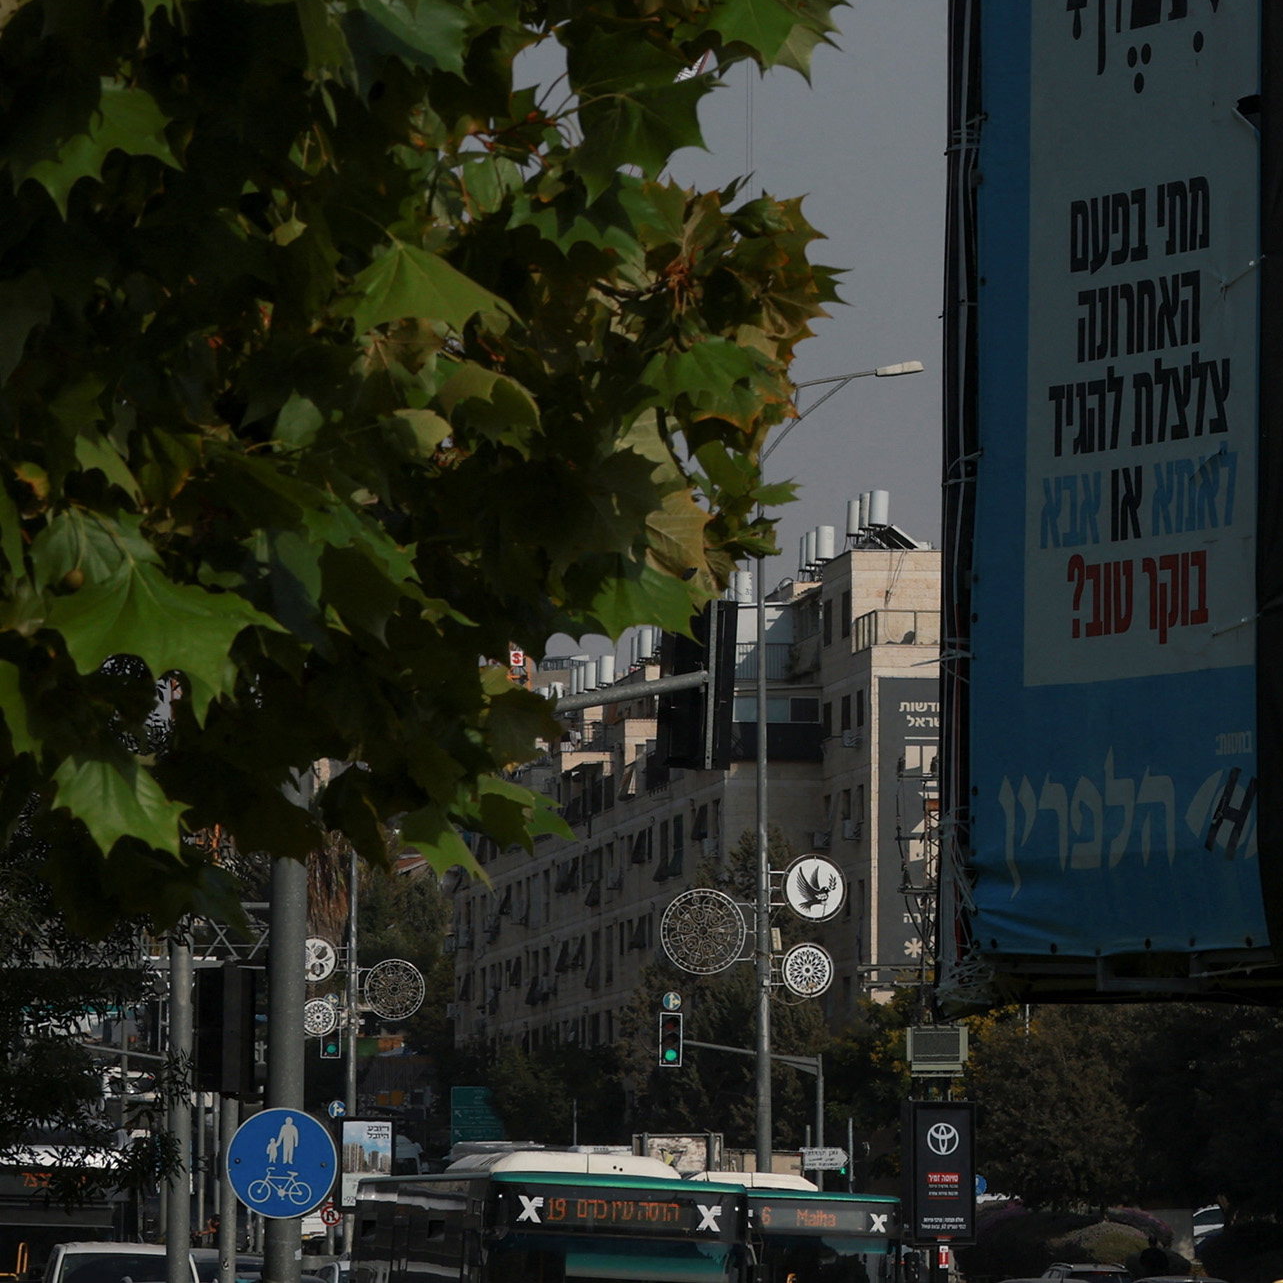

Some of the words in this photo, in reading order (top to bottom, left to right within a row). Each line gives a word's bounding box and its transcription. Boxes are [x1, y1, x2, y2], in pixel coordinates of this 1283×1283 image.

[1070, 188, 1148, 275] בפעם
[1157, 176, 1210, 255] מתי
[1077, 270, 1200, 363] האחרונה
[1049, 366, 1124, 457] להגיד
[1131, 351, 1230, 447] צלצלת
[1040, 471, 1101, 549] אבא
[1111, 465, 1142, 542] או
[1152, 441, 1239, 537] לאמא
[1067, 554, 1133, 639] טוב?
[1142, 550, 1209, 644] בוקר
[899, 701, 939, 712] דשות
[998, 744, 1176, 902] הלפרין
[547, 1197, 567, 1220] 19
[577, 1198, 608, 1219] כרם
[612, 1200, 634, 1222] עין
[796, 1208, 838, 1227] Malha
